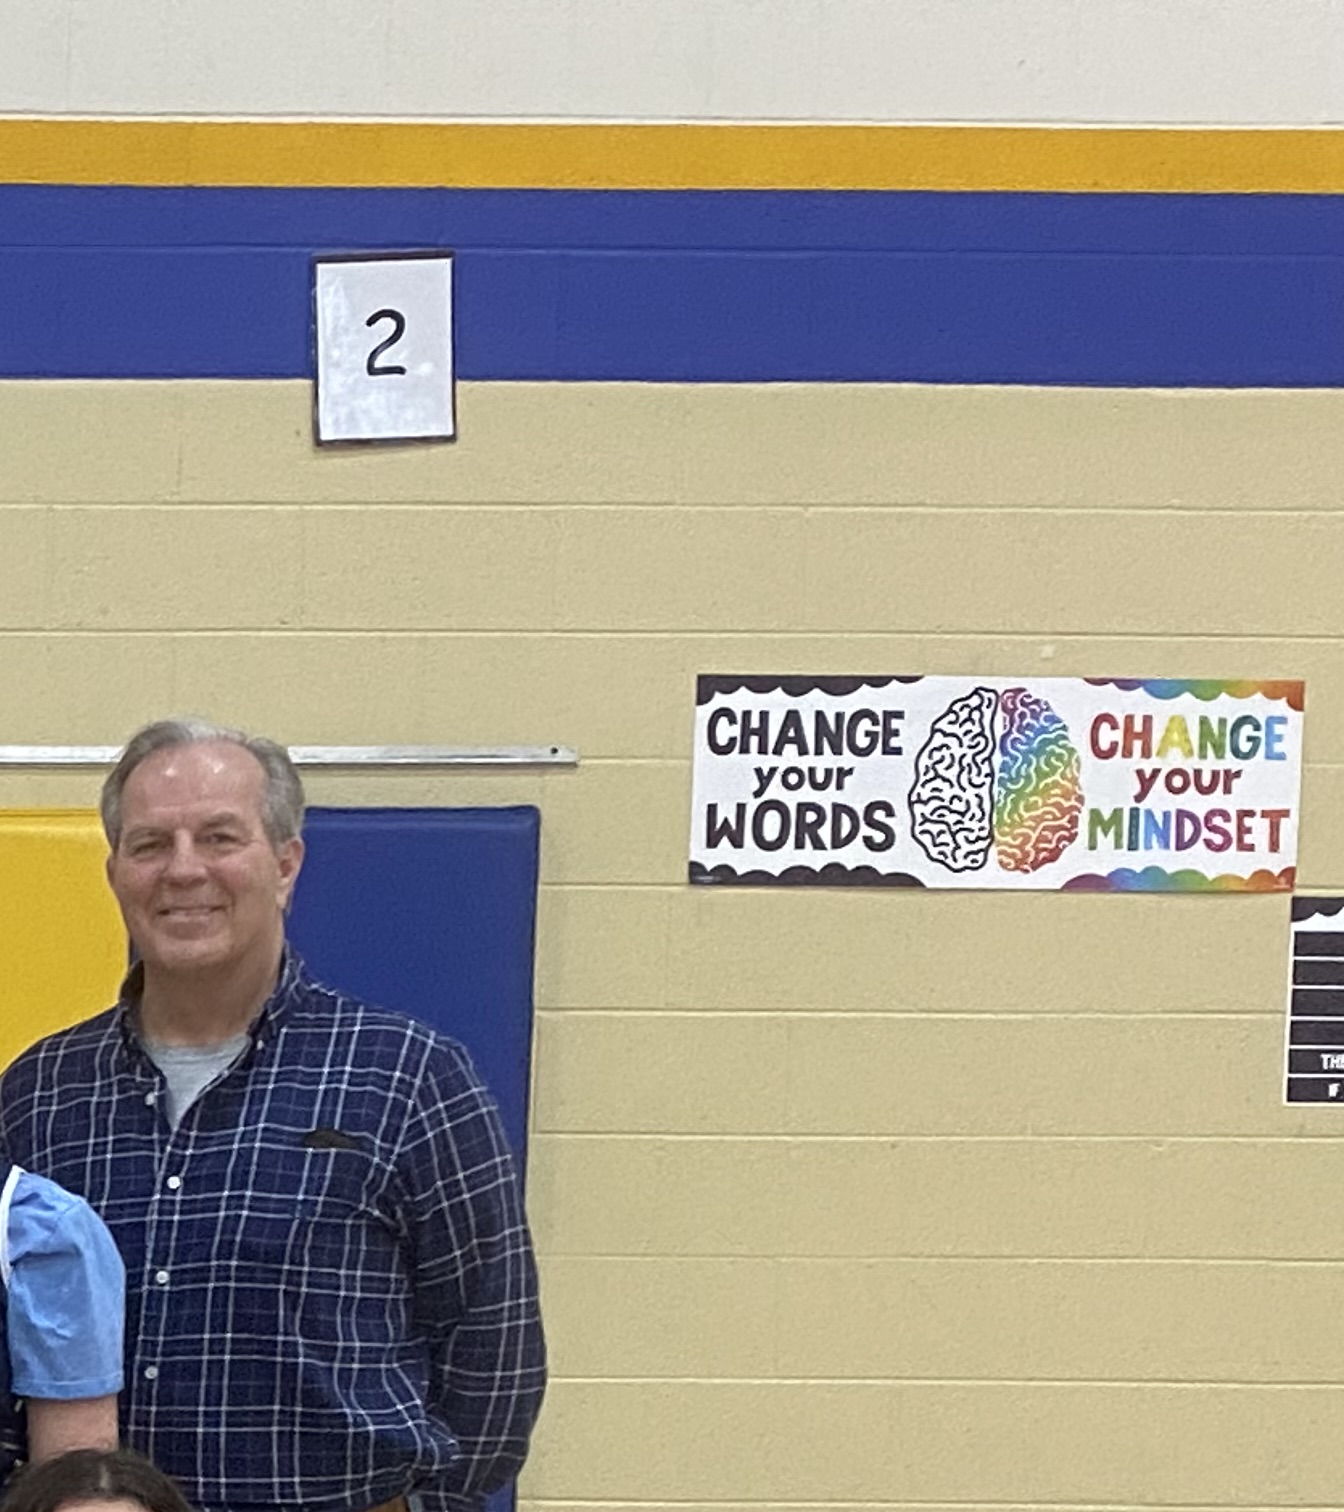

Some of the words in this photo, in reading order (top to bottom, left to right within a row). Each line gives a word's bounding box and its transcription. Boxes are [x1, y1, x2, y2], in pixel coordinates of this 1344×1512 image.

[365, 308, 407, 376] 2
[706, 706, 904, 756] CHANGE
[1089, 714, 1288, 761] CHANGE
[752, 764, 854, 798] your
[1133, 765, 1243, 804] your
[705, 799, 897, 852] WORDS
[1086, 807, 1290, 853] MINDSET
